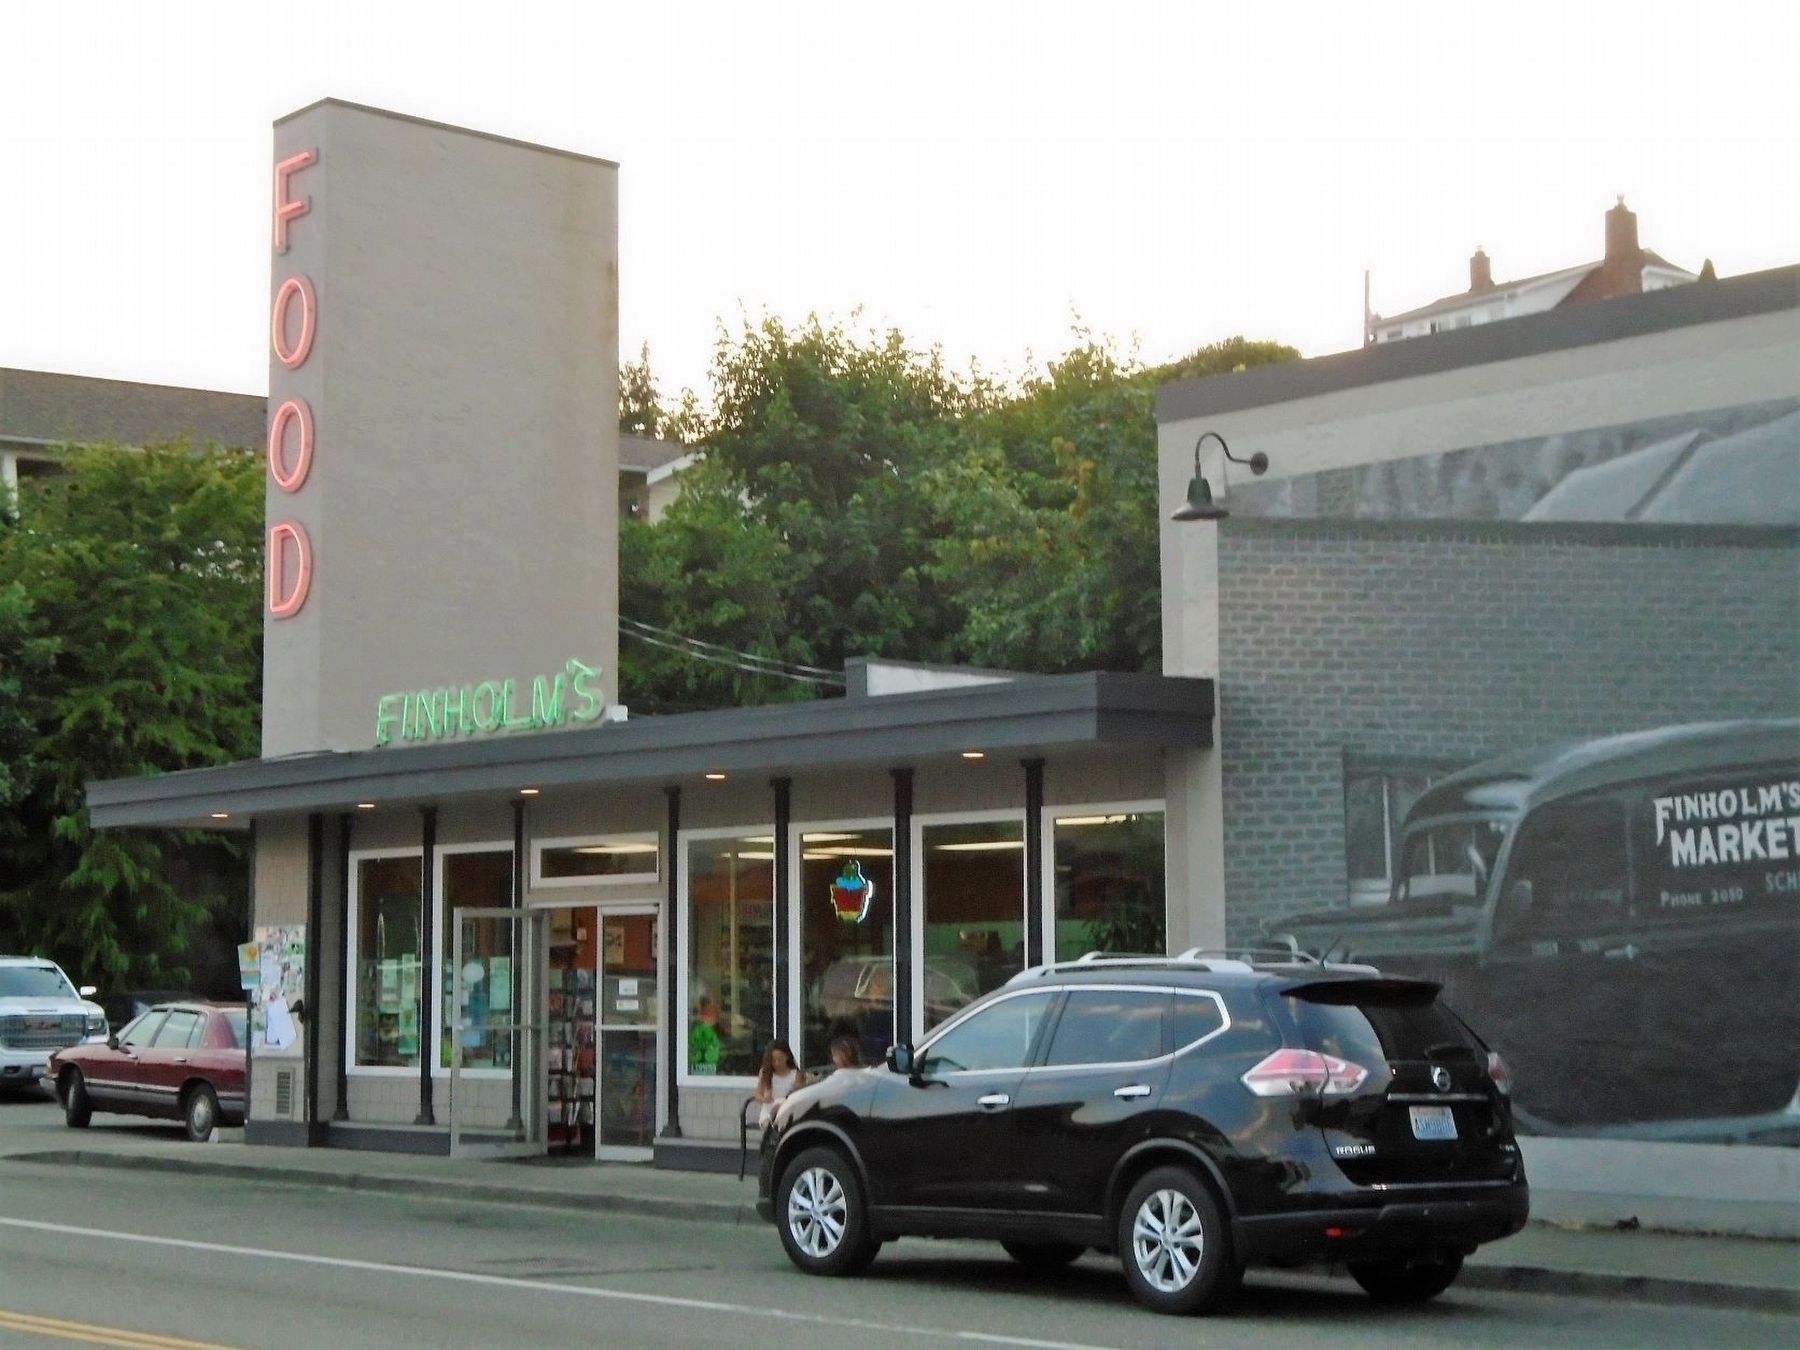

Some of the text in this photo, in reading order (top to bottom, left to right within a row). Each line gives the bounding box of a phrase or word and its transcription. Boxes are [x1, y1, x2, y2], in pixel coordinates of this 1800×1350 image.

[270, 148, 317, 621] FOOD
[376, 657, 604, 743] FINHOLM'S
[1653, 782, 1800, 847] FINHOLM'S
[1670, 817, 1800, 868] MARKET
[1765, 871, 1800, 892] SCH
